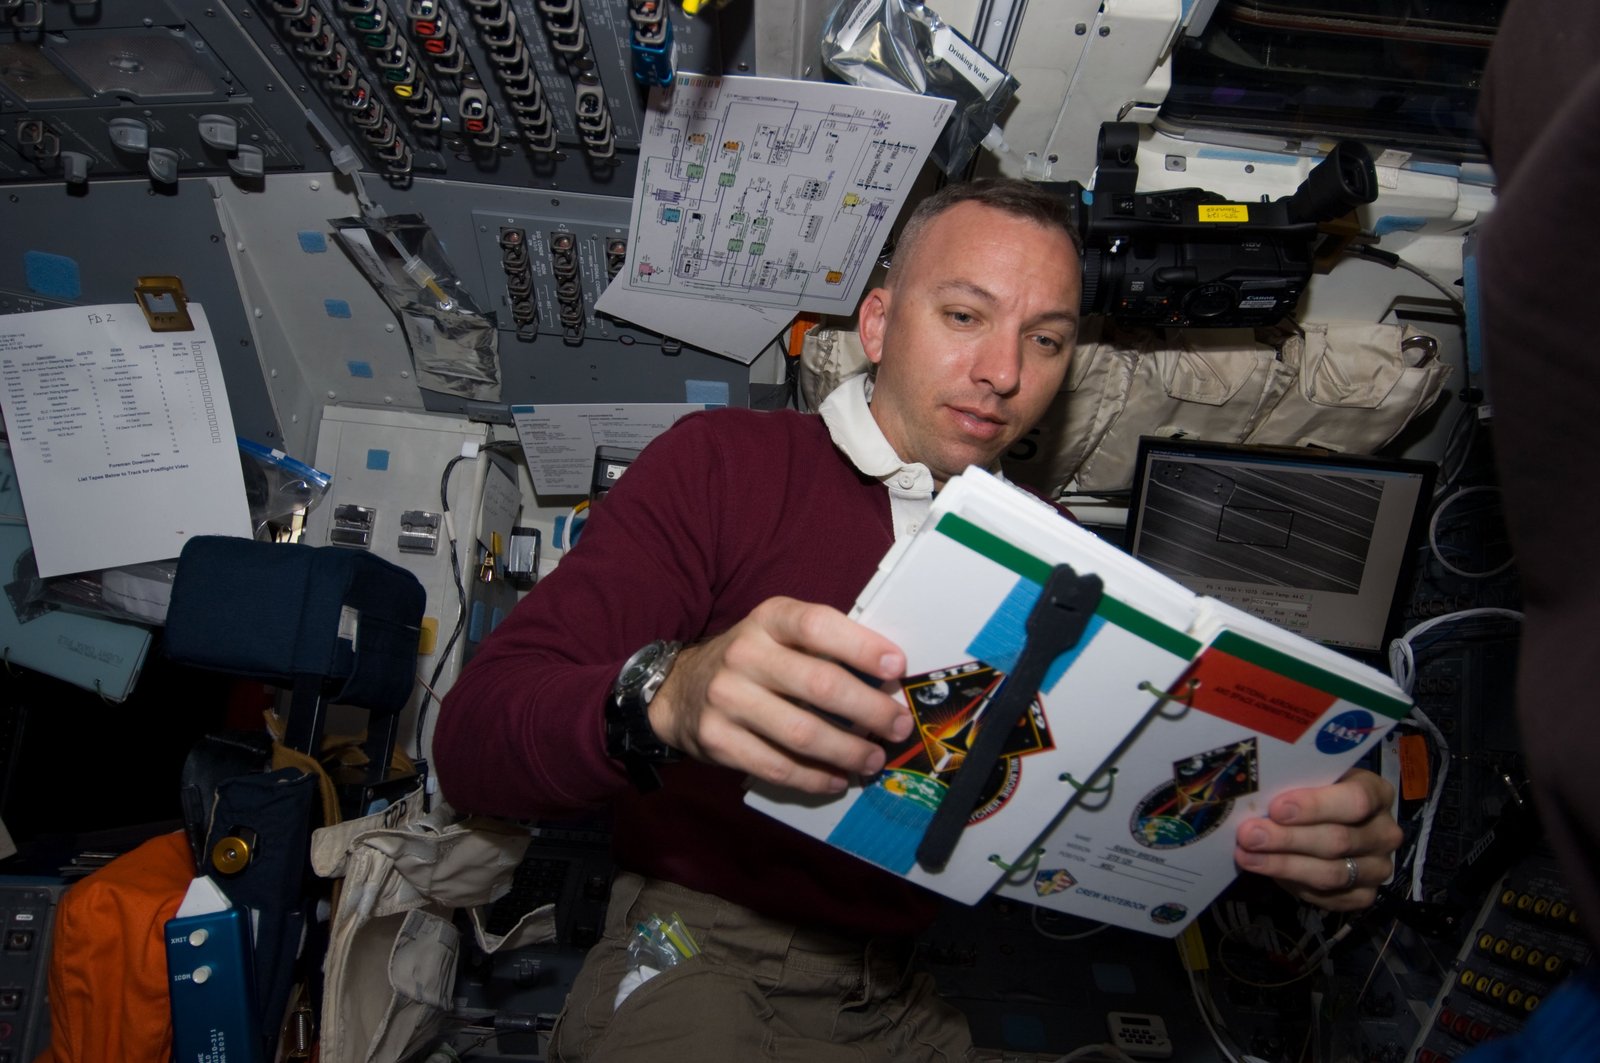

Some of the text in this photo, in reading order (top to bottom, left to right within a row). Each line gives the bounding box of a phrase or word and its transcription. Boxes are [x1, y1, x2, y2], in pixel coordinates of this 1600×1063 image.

[948, 44, 990, 83] Drinking Water
[87, 313, 116, 325] FD 2
[150, 465, 174, 473] Postflight
[928, 662, 980, 681] STS
[967, 756, 1020, 824] WILMORE TCHER
[1075, 886, 1148, 911] CREW NOTEBOOK
[171, 936, 188, 945] XMIT
[174, 973, 191, 982] ICOM
